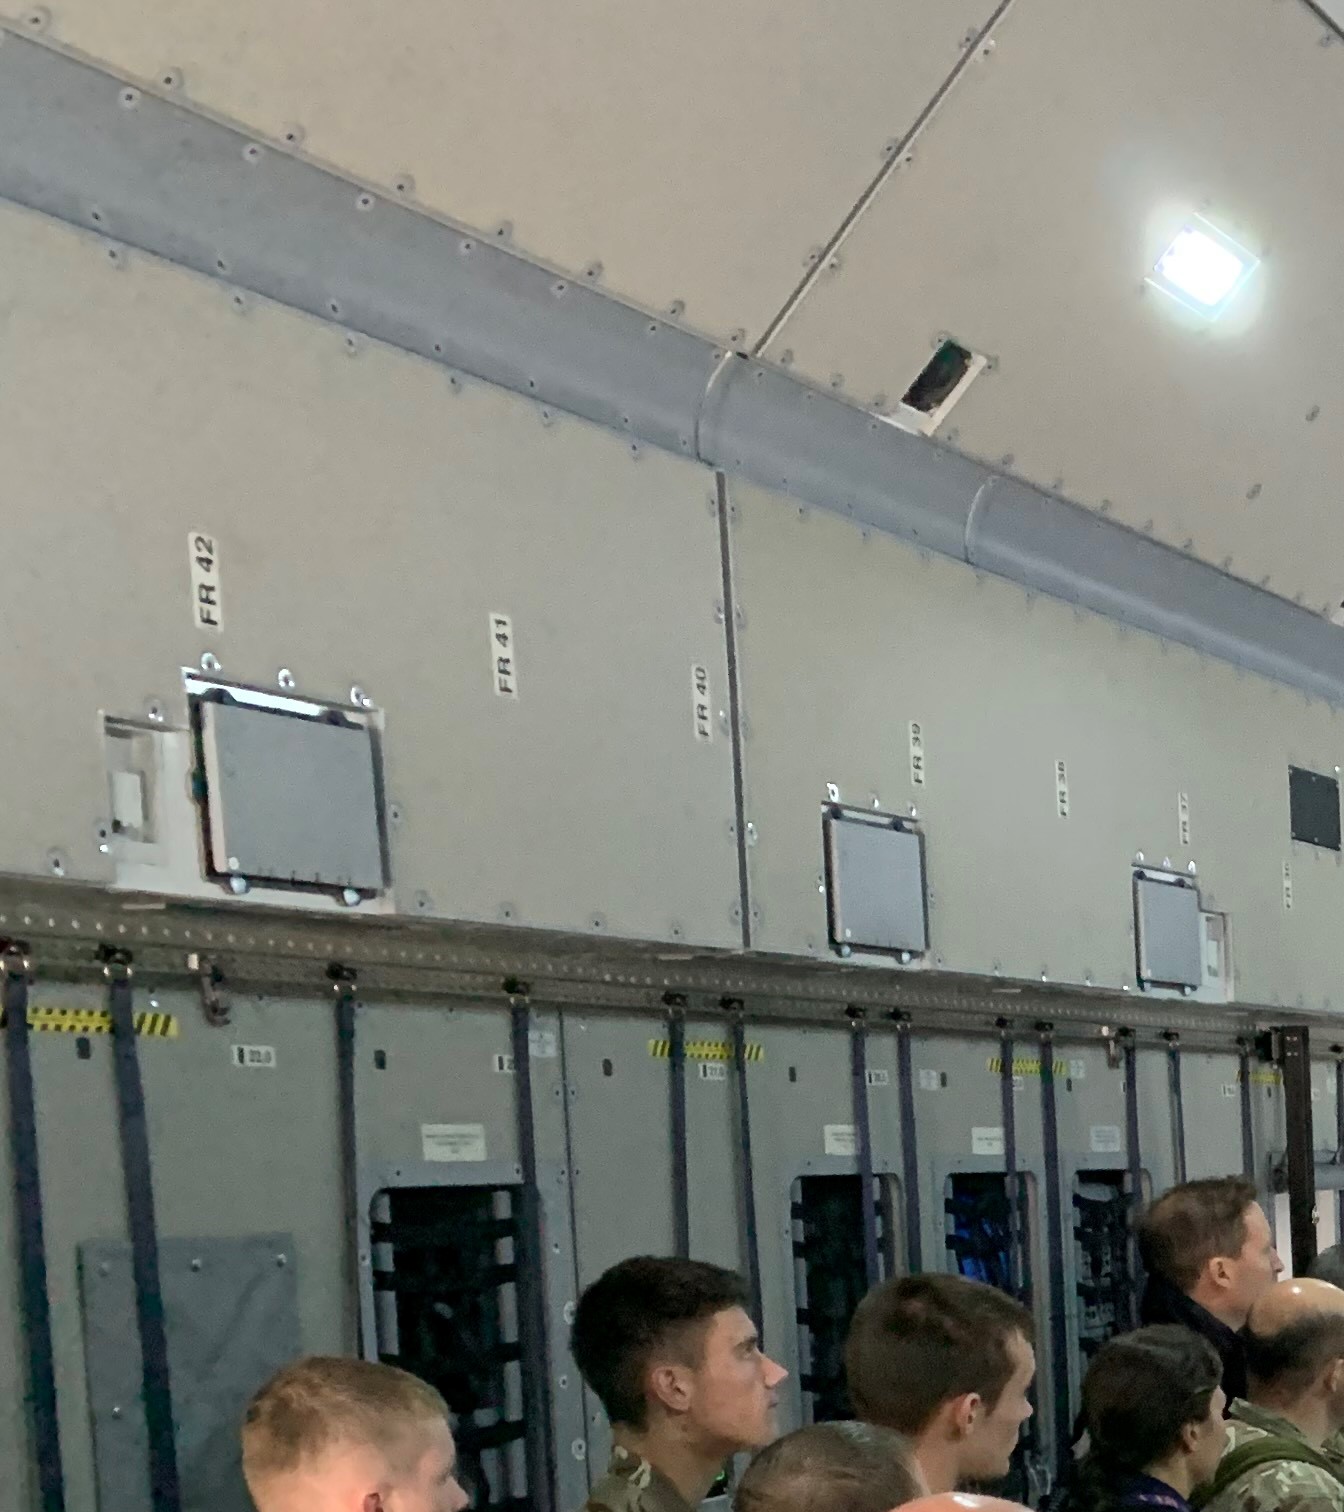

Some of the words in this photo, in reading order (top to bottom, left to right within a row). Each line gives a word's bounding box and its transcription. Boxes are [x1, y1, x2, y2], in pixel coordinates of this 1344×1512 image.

[194, 535, 214, 573] 42
[198, 582, 218, 626] FR
[494, 618, 509, 648] 41
[497, 656, 513, 693] FR
[695, 666, 706, 696] 40
[696, 703, 709, 737] FR
[913, 755, 923, 784] FR
